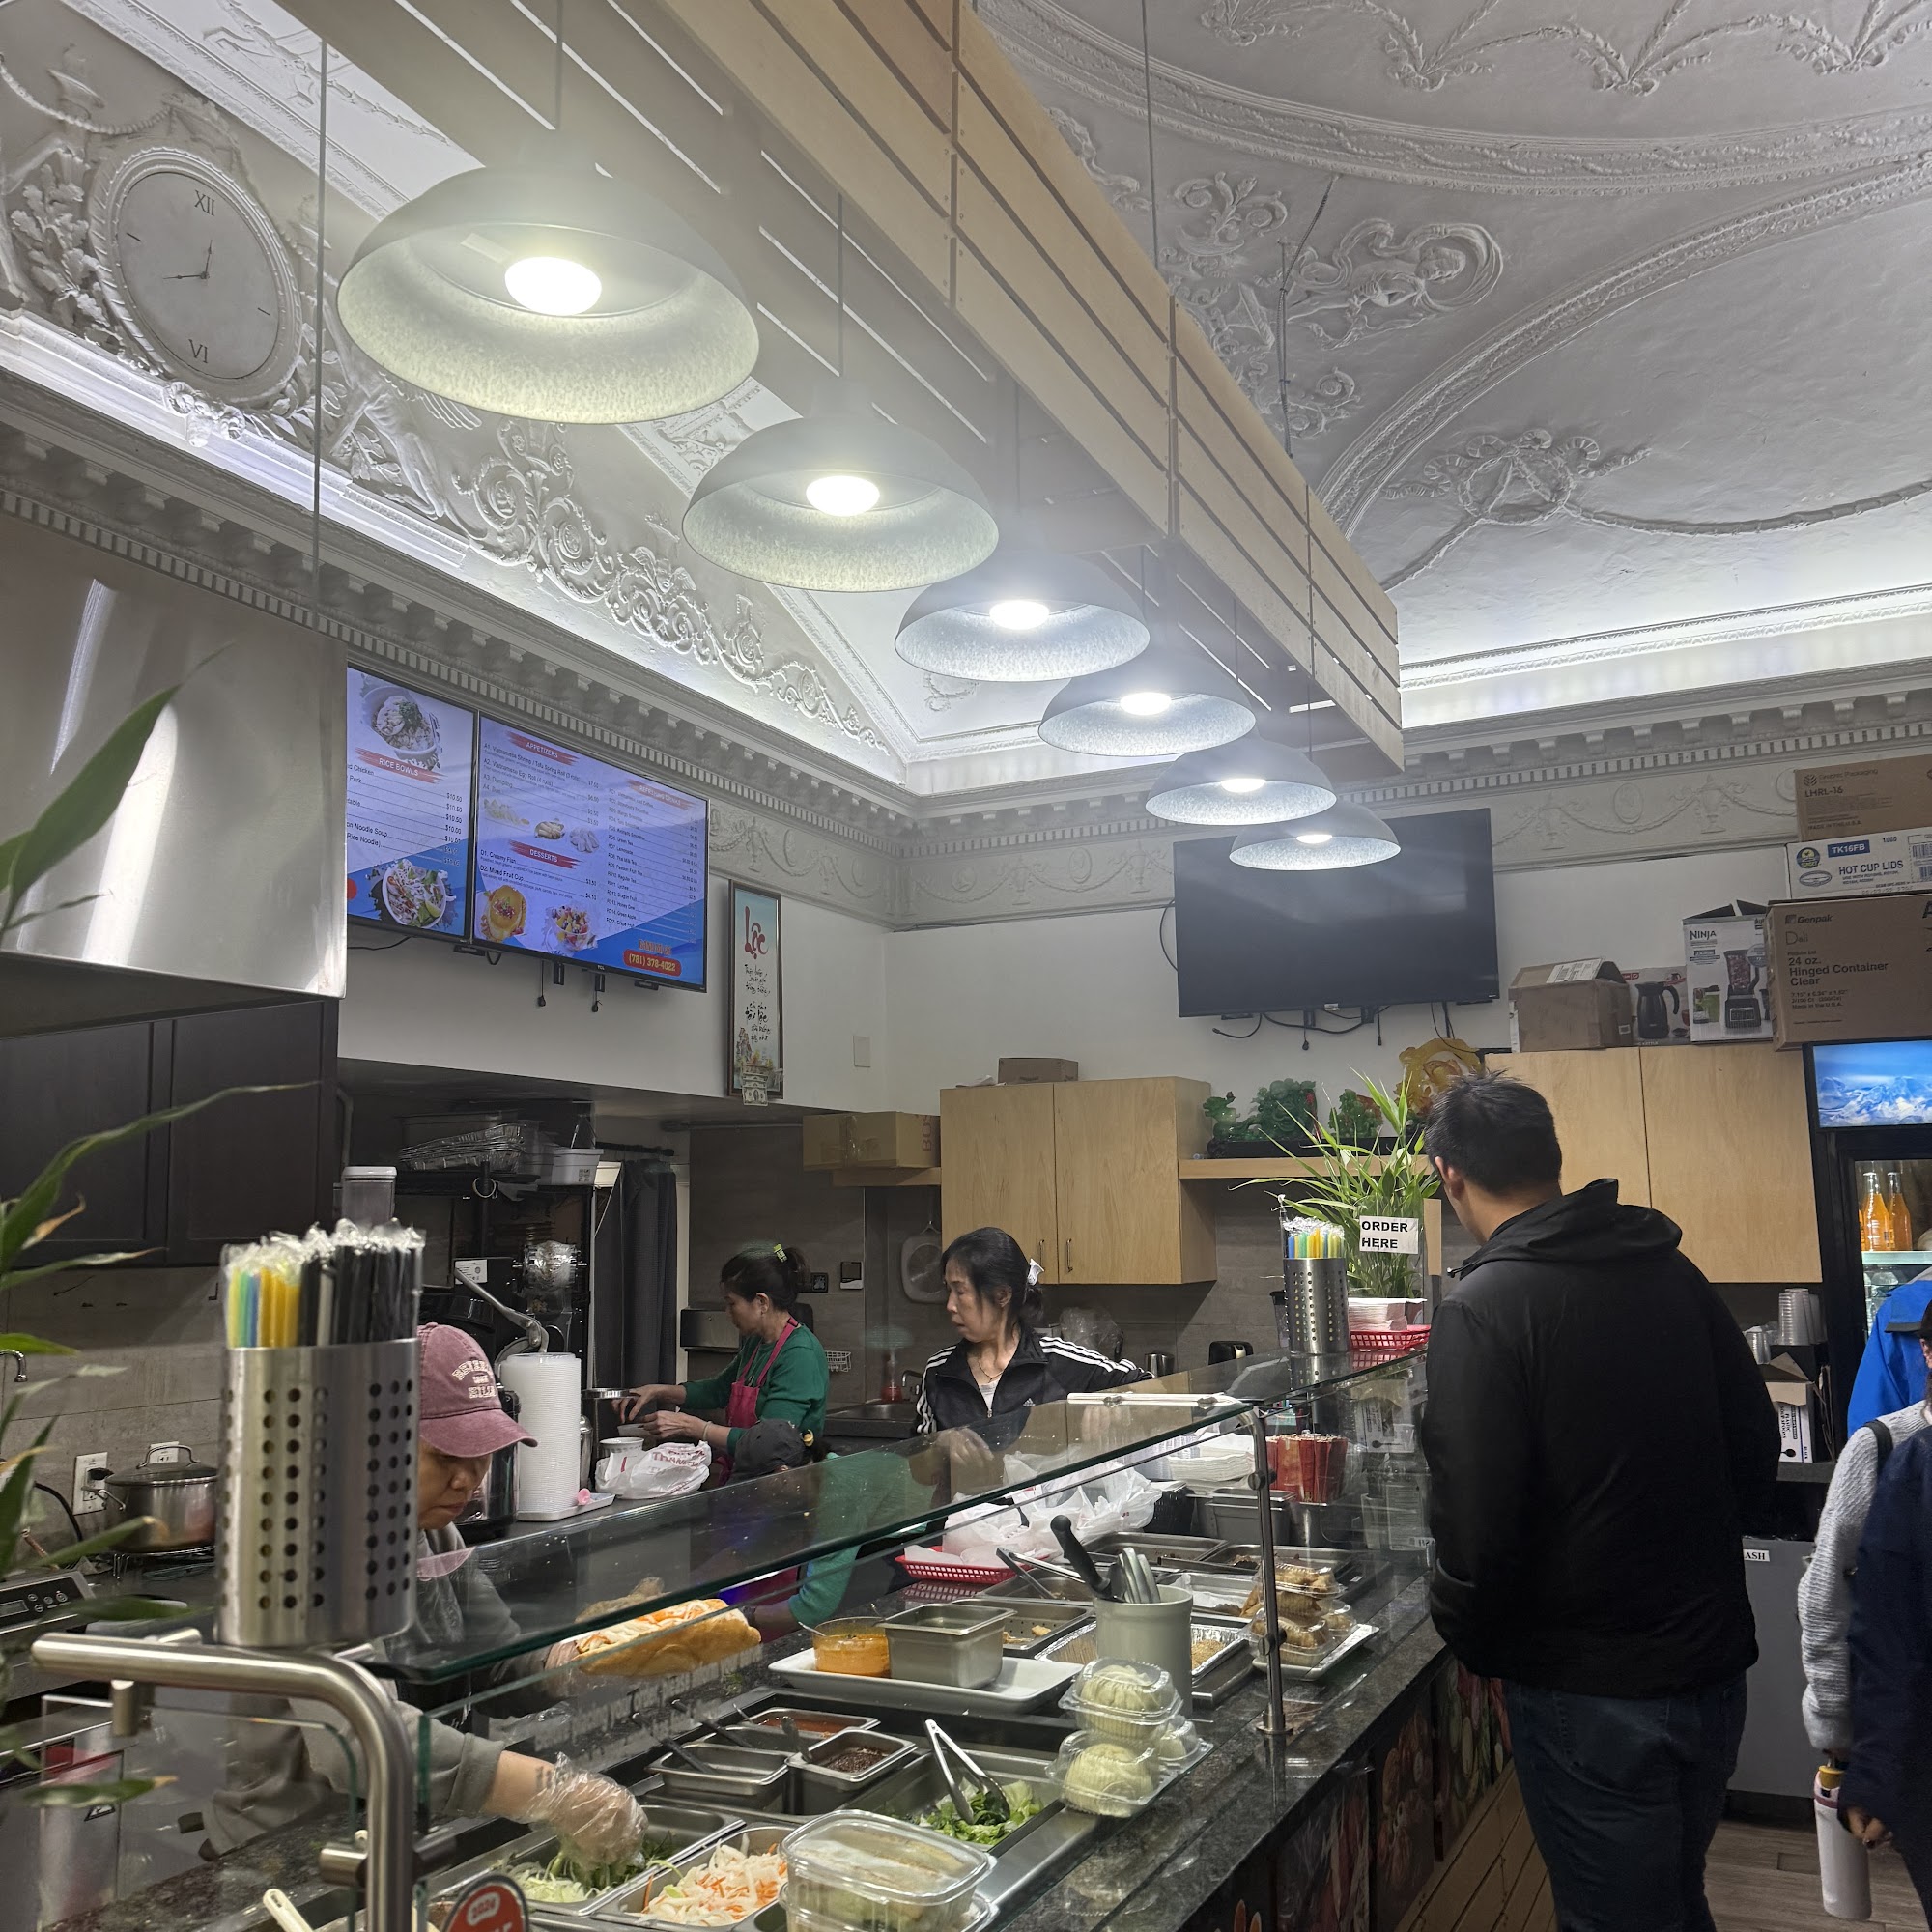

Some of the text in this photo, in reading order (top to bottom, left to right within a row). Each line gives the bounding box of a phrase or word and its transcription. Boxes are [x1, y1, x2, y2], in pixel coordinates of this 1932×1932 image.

[195, 190, 215, 216] XII
[189, 339, 209, 363] VI
[354, 765, 374, 776] Chicken
[379, 758, 418, 776] RICE BOWLS
[350, 775, 362, 783] Pork
[1804, 786, 1844, 797] LHRL-16
[355, 823, 373, 834] Noodle
[375, 828, 388, 838] Soup
[1832, 843, 1865, 854] TK16FB
[529, 848, 558, 863] DESSERTS
[1839, 865, 1858, 875] HOT
[1860, 863, 1880, 873] CUP
[1883, 860, 1904, 870] LIDS
[1798, 914, 1833, 924] Genpak
[1690, 930, 1717, 941] NINJA
[1786, 930, 1808, 945] Dali
[629, 953, 676, 972] (781) 378-4022
[1788, 957, 1802, 966] 24
[1789, 962, 1889, 978] Hinged Container
[1790, 976, 1820, 986] Clear
[1361, 1220, 1408, 1233] ORDER
[1361, 1237, 1398, 1249] HERE
[1745, 1551, 1766, 1561] ASH
